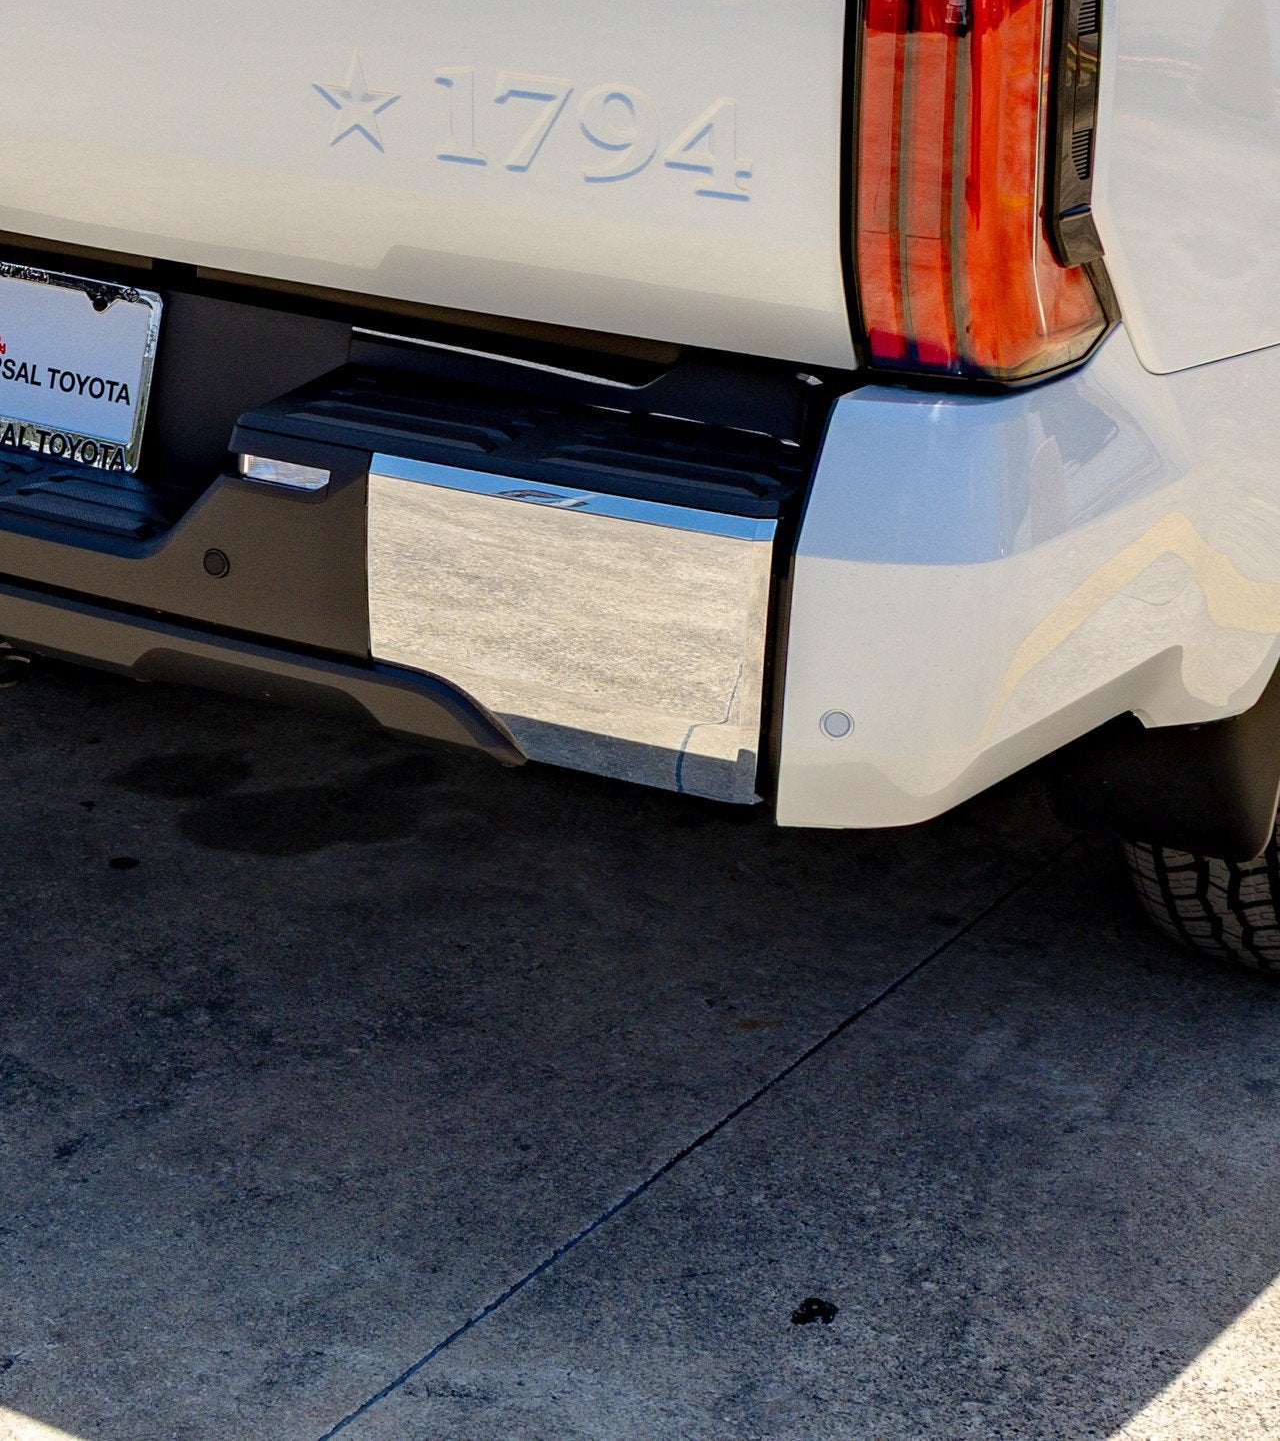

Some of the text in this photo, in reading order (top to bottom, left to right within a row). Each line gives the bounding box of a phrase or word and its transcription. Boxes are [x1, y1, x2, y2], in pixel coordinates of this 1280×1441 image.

[433, 65, 753, 202] 1794
[47, 367, 131, 405] TOYOTA
[36, 429, 127, 471] TOYOTA
